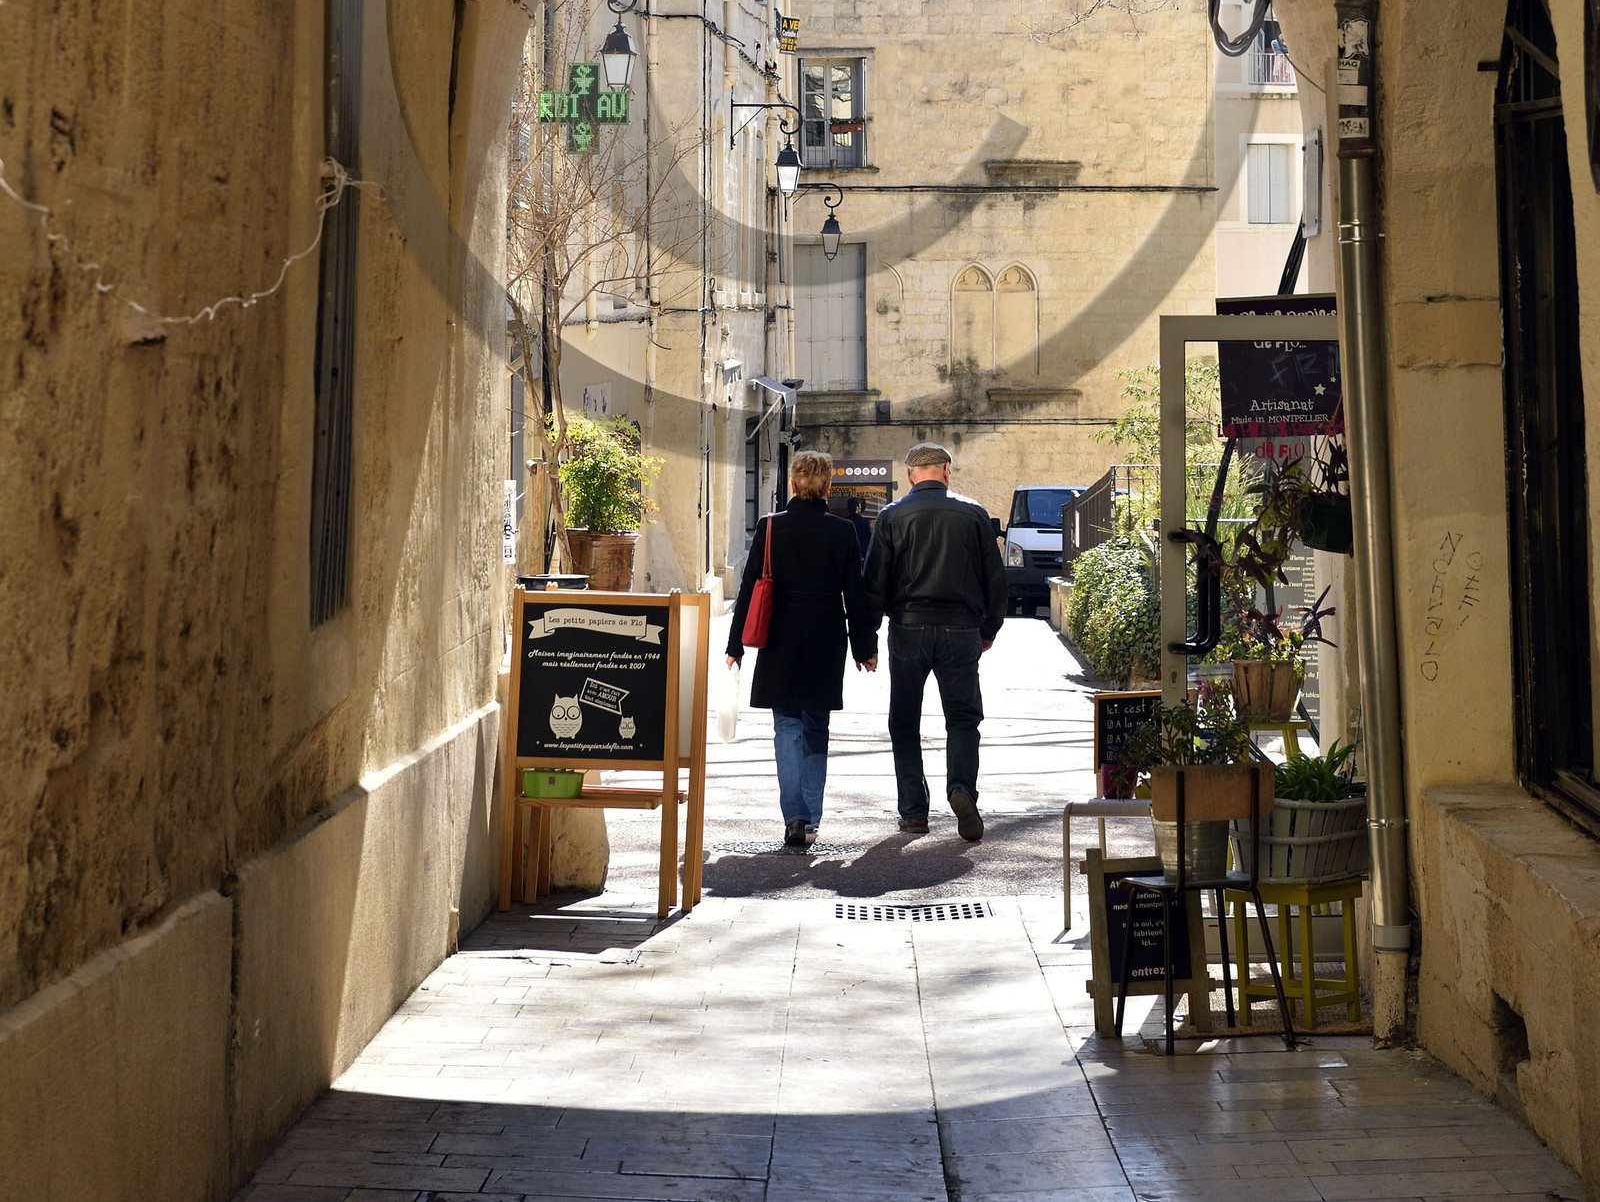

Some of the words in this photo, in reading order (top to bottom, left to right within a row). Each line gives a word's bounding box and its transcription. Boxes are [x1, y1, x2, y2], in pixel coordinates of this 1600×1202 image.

[597, 93, 625, 118] AU
[1249, 398, 1314, 411] Artisanat
[1231, 416, 1252, 425] Made
[1255, 415, 1265, 423] in
[1268, 413, 1329, 423] MONTPELLIER
[563, 617, 585, 625] petits
[588, 618, 616, 626] papiers
[619, 618, 627, 626] de
[528, 649, 555, 658] Maison
[556, 650, 610, 661] imaginairement
[609, 652, 632, 661] fondée
[560, 660, 595, 668] réellement
[594, 661, 618, 671] fondée
[597, 691, 617, 703] AMOUR
[1124, 716, 1132, 728] la
[543, 741, 634, 752] www.lespetitspapiersdeflo.com
[1133, 929, 1163, 938] fabriqué
[1131, 966, 1166, 977] entrez
